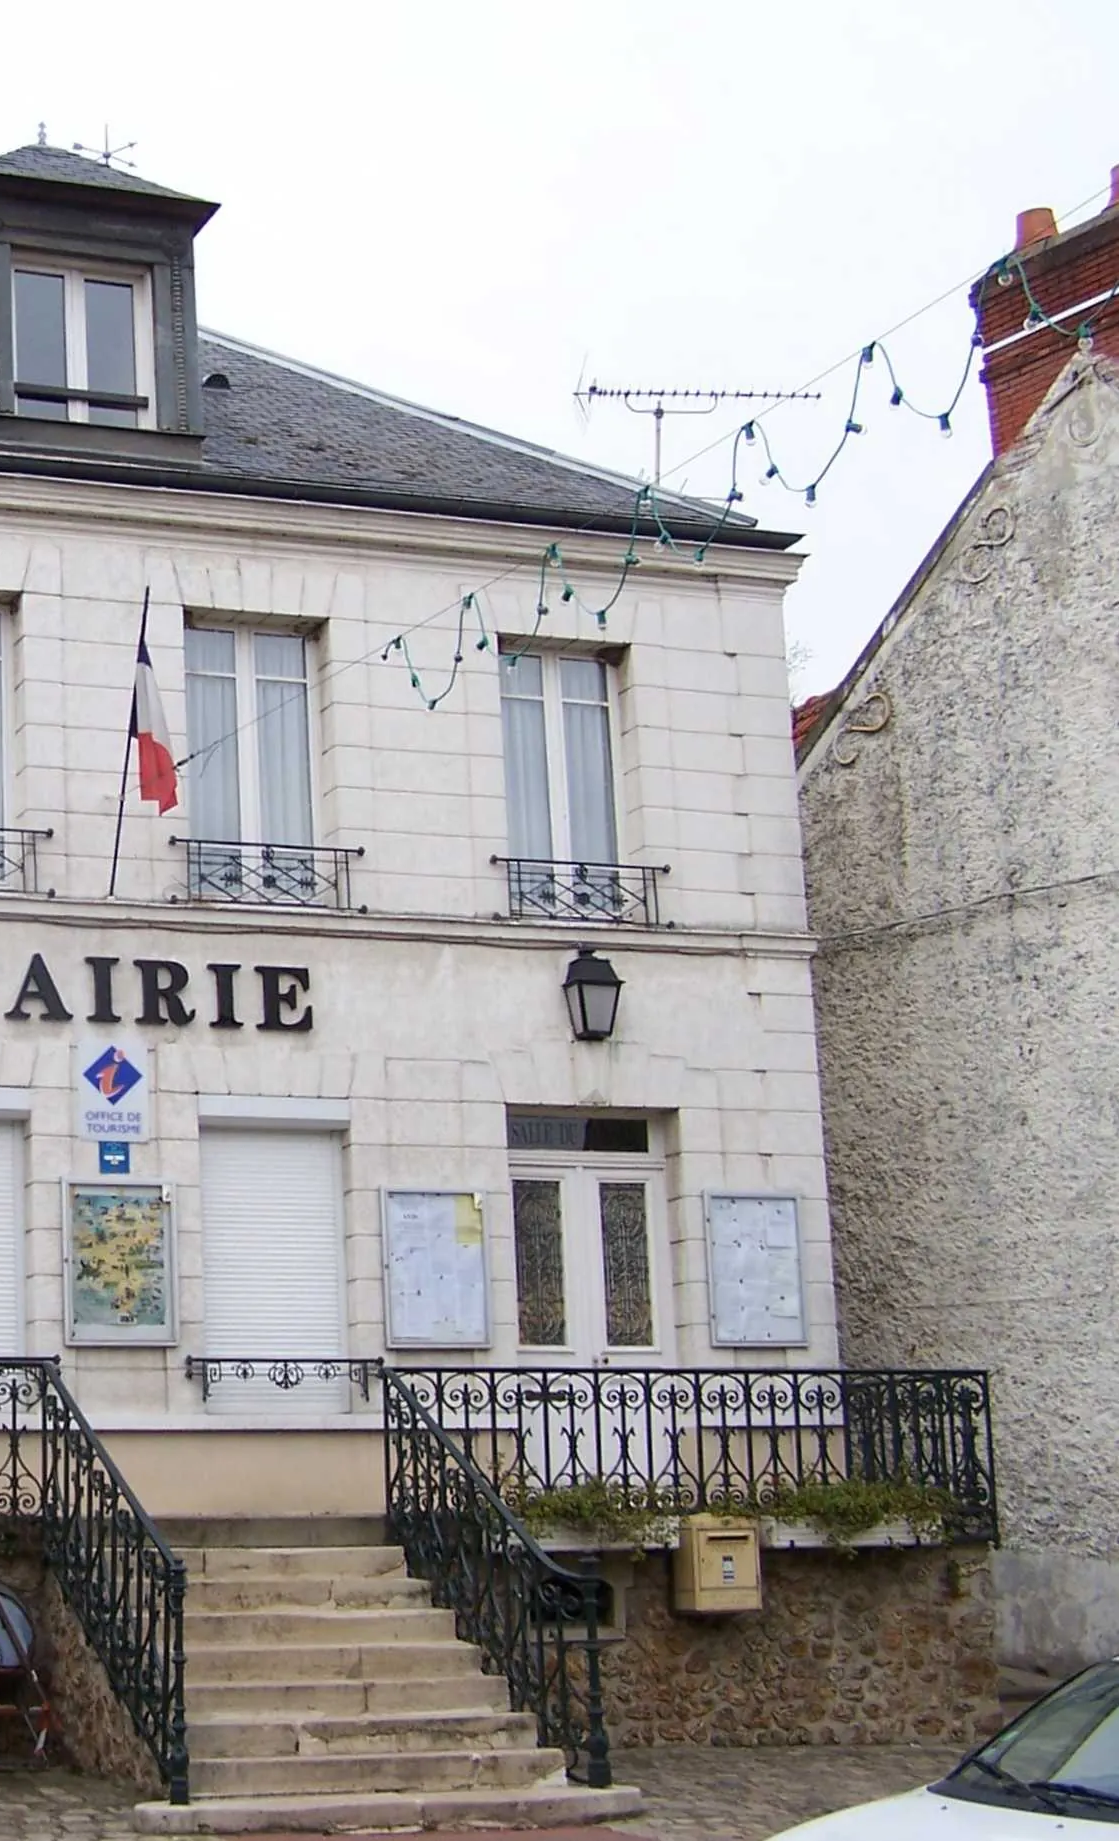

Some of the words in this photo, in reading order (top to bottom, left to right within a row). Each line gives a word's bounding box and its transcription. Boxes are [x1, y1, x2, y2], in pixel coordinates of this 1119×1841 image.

[85, 1111, 123, 1121] OFFICE
[127, 1111, 141, 1122] DE
[87, 1123, 141, 1134] TOURISME
